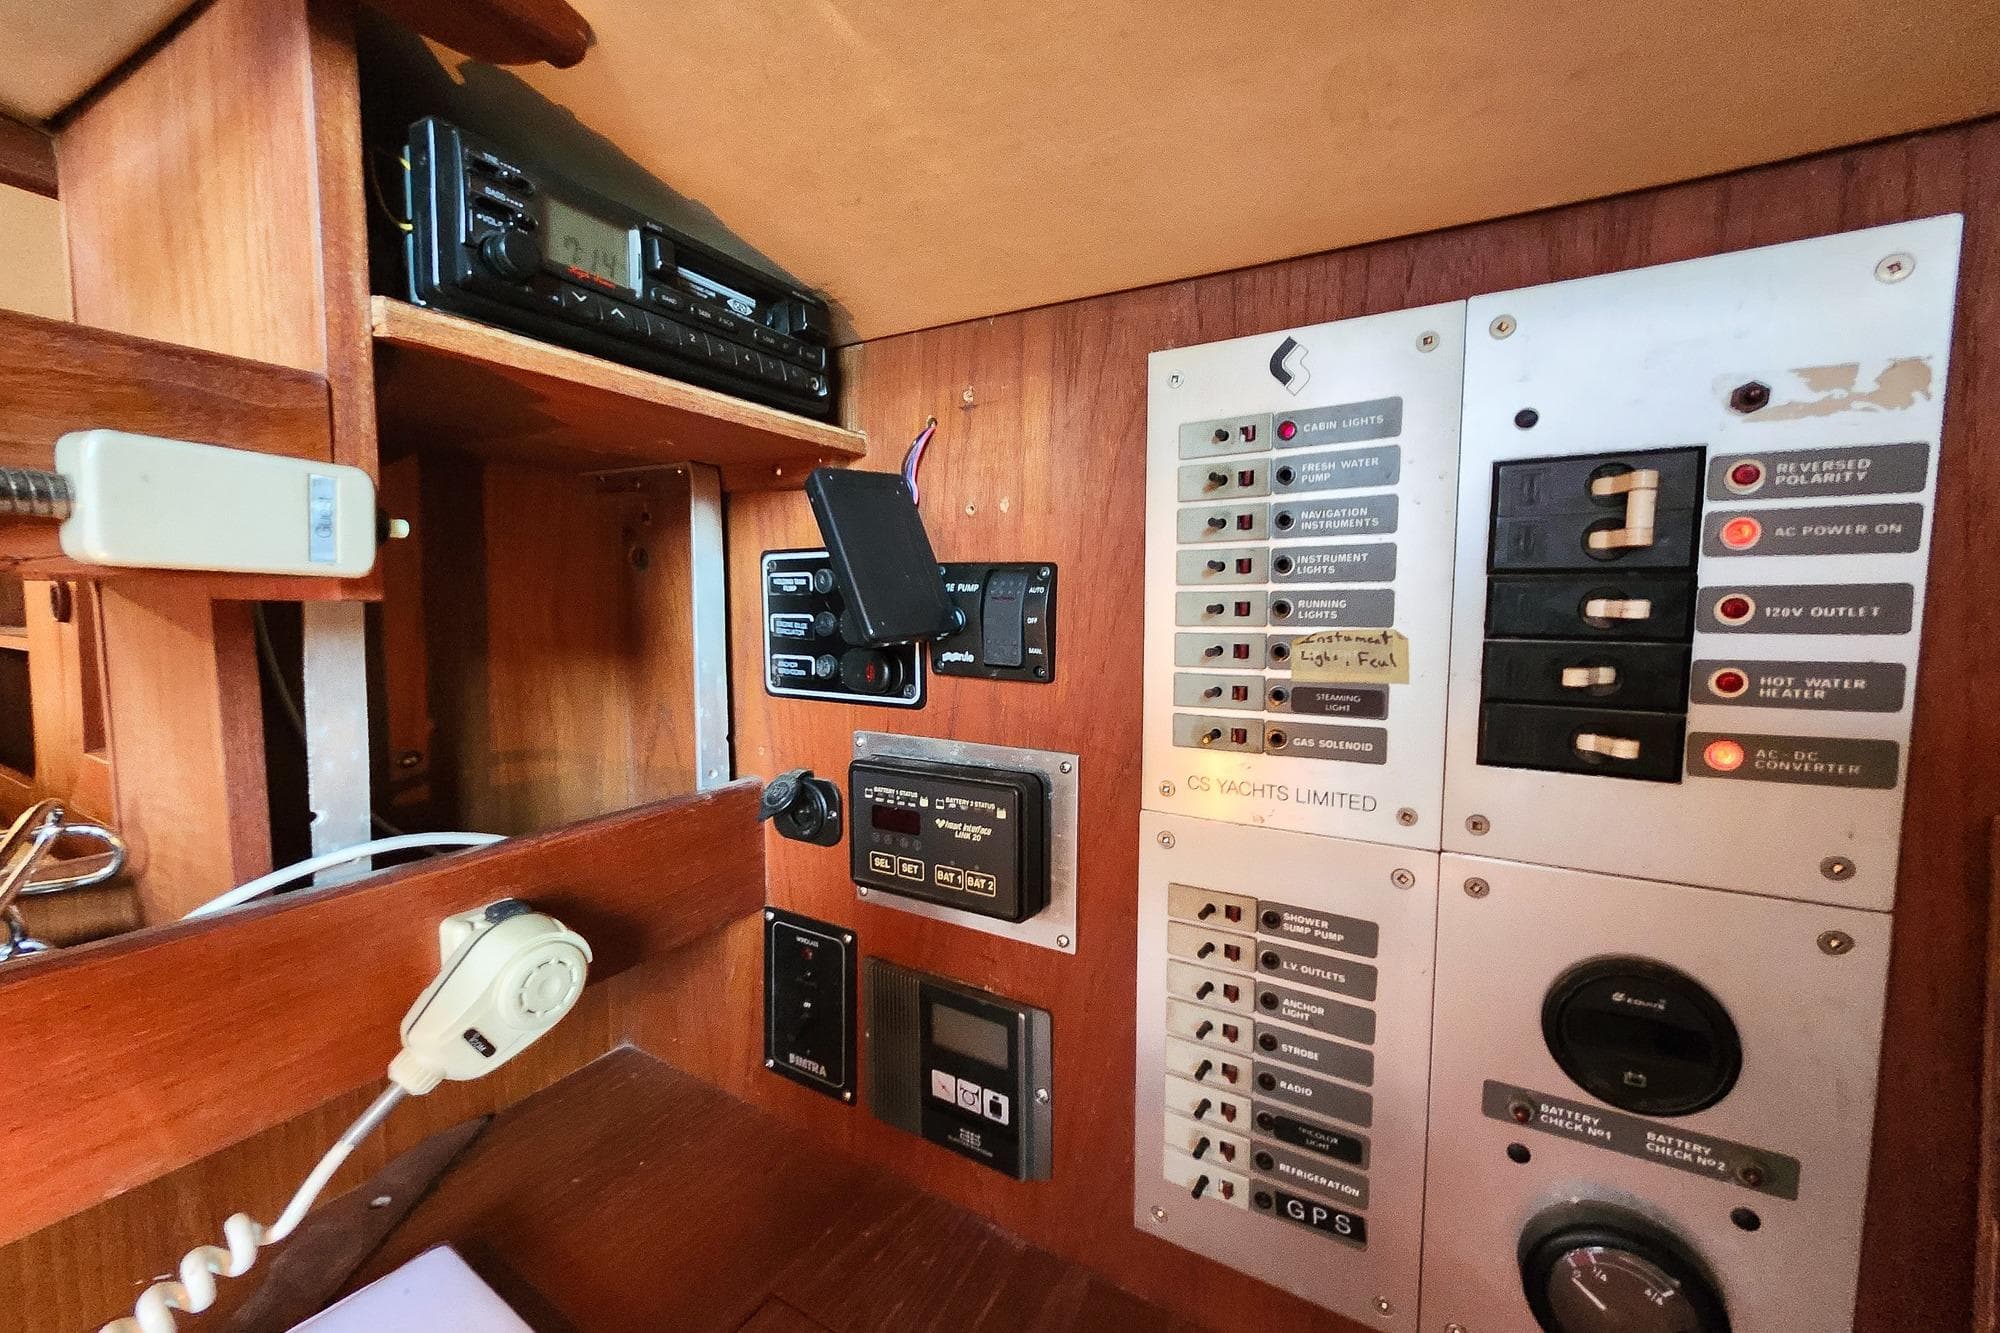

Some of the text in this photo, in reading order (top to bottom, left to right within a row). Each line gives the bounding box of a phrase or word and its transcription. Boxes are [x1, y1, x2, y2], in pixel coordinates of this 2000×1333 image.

[1303, 414, 1384, 433] CABIN LIGHTS
[1302, 457, 1379, 472] FRESH WATER
[1775, 458, 1871, 474] REVERSED
[1301, 472, 1331, 483] PUMP
[1775, 472, 1868, 486] POLARITY
[1301, 507, 1368, 519] NAVIGATION
[1301, 517, 1379, 530] INSTRUMENTS
[1775, 523, 1903, 537] AC POWER ON
[1297, 552, 1369, 565] INSTRUMENT
[1297, 564, 1336, 575] LIGHTS
[958, 583, 979, 592] PUMP
[1298, 599, 1347, 609] RUNNING
[1298, 609, 1338, 619] LIGHTS
[1765, 606, 1881, 618] 120V OUTLET
[1760, 677, 1866, 690] HOT WATER
[1315, 692, 1361, 703] STEAMING
[1759, 688, 1826, 699] HEATER
[1325, 702, 1351, 712] LIGHT
[1293, 737, 1373, 751] GAS SOLENOID
[1756, 749, 1780, 760] AC
[1794, 750, 1819, 761] DC
[1755, 759, 1862, 775] CONVERTER
[874, 787, 895, 795] BATTERY
[900, 790, 918, 798] STATUS
[1187, 775, 1377, 812] CS YACHTS LIMITED
[945, 797, 970, 806] BATTERY
[975, 801, 995, 810] STATUS
[955, 831, 982, 842] LINK 20
[874, 857, 890, 869] SEL
[901, 863, 918, 874] SET
[937, 870, 955, 883] BAT
[967, 877, 994, 891] BAT 2
[1283, 911, 1329, 929] SHOWER
[1282, 922, 1345, 942] SUMP PUMP
[1301, 964, 1346, 983] OUTLETS
[1282, 998, 1325, 1016] ANCHOR
[1282, 1007, 1310, 1021] LIGHT
[1281, 1043, 1319, 1061] STROBE
[1279, 1079, 1313, 1097] RADIO
[1540, 1103, 1600, 1126] BATTERY
[1540, 1114, 1583, 1132] CHECK
[1646, 1131, 1712, 1156] BATTERY
[1645, 1142, 1693, 1162] CHECK
[1279, 1162, 1360, 1198] REFRIGERATION
[1287, 1199, 1352, 1235] GPS
